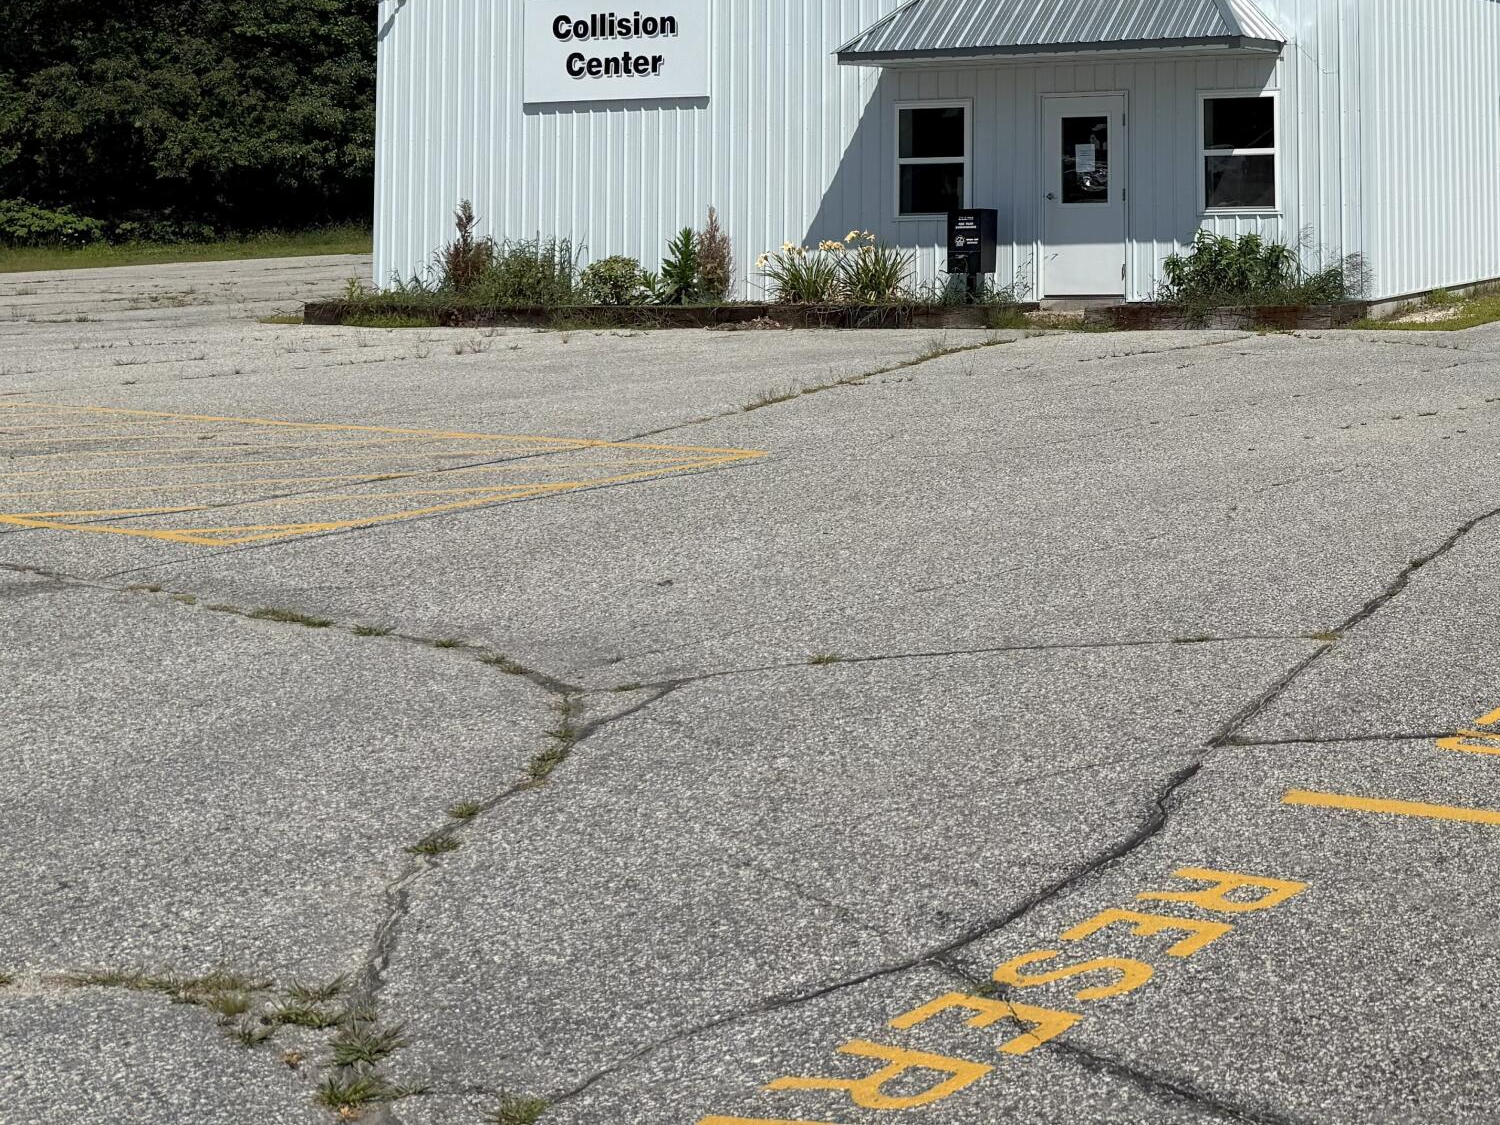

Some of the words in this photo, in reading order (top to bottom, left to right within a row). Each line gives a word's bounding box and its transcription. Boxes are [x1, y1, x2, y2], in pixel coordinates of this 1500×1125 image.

[552, 11, 677, 40] Collision
[566, 51, 663, 78] Center
[698, 867, 1308, 1125] RESER
